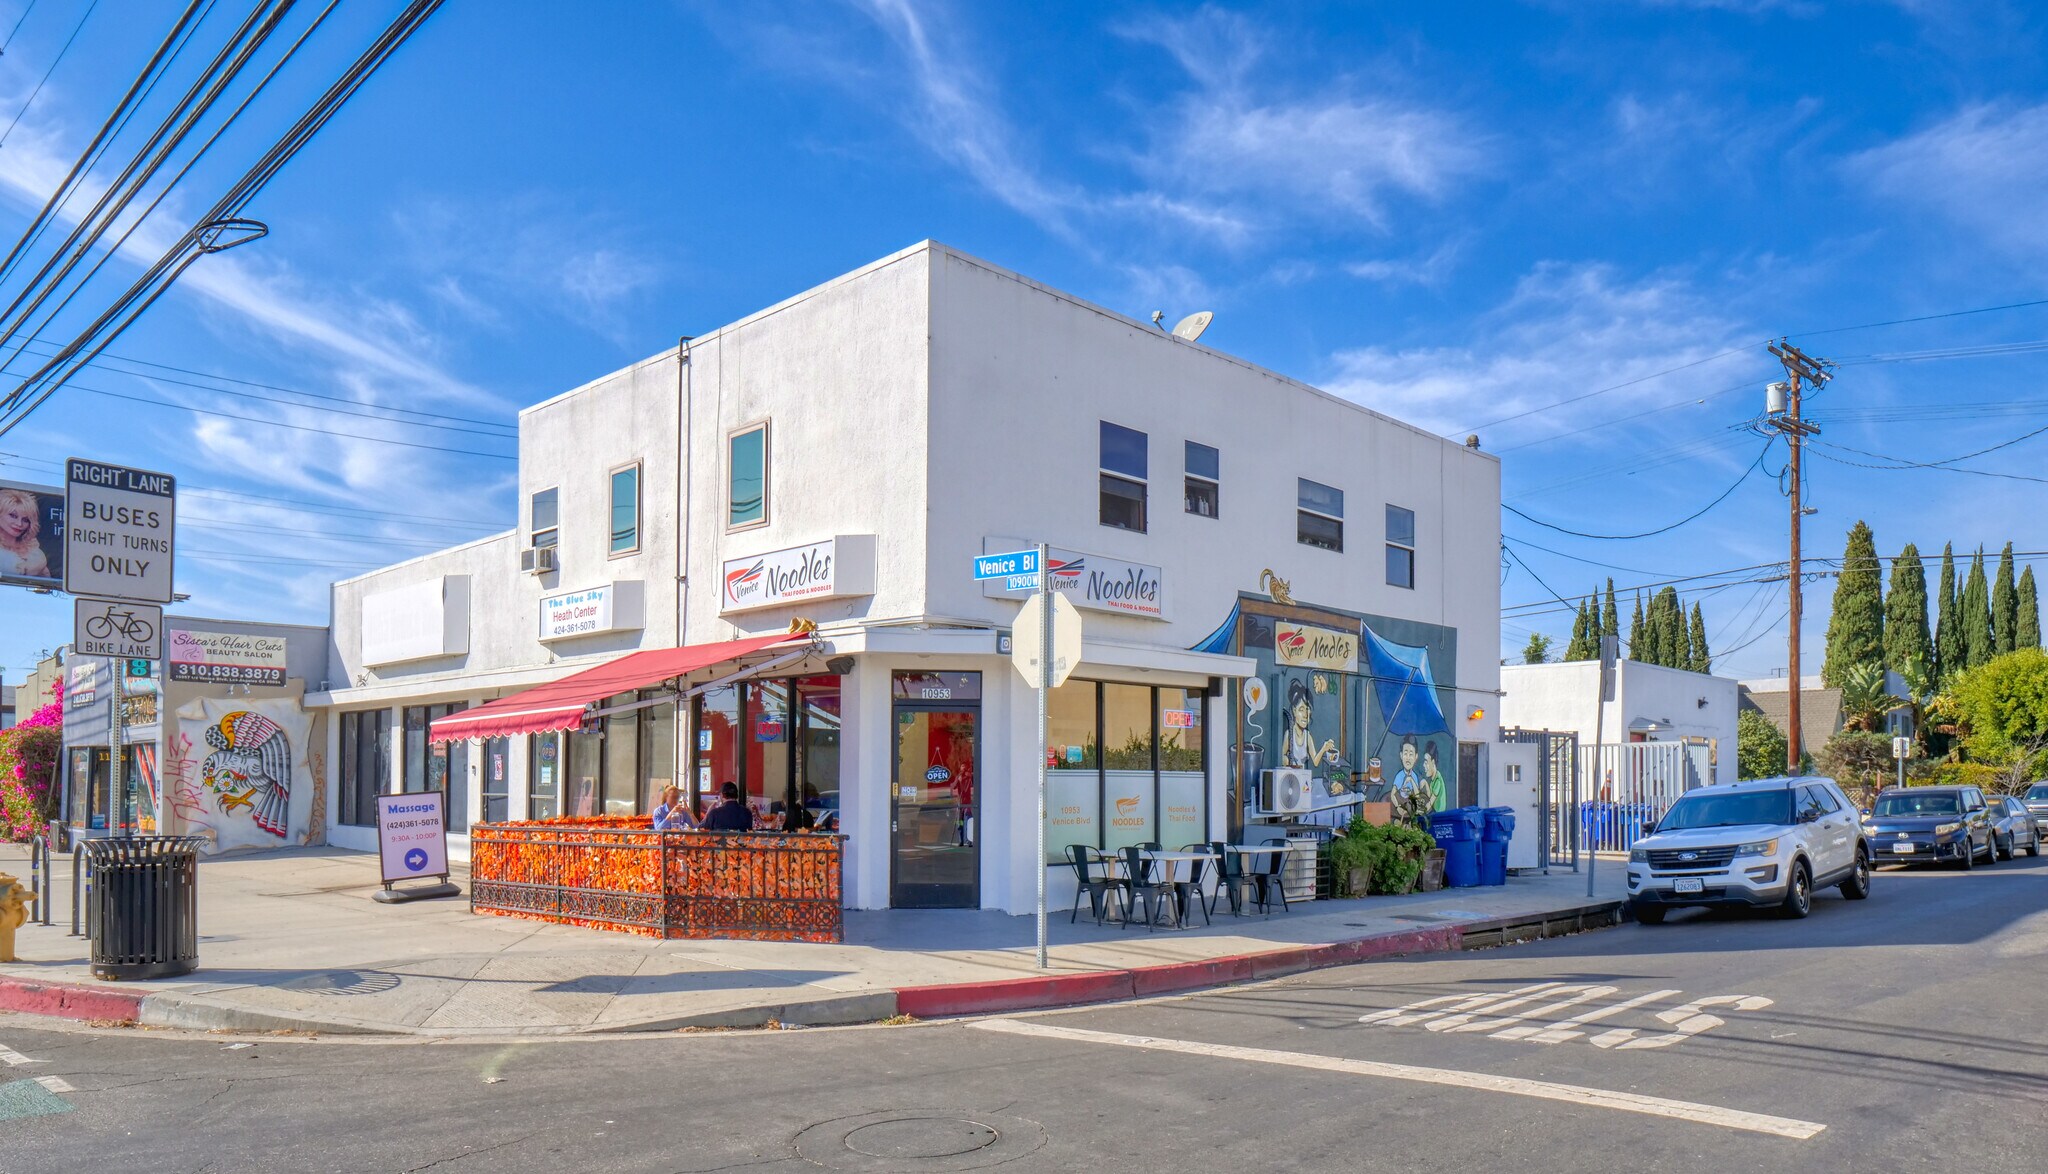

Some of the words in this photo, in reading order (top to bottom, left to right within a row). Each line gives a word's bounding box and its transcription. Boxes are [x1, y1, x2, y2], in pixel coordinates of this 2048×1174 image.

[72, 462, 122, 486] RIGHT
[128, 472, 170, 494] LANE
[82, 501, 160, 529] BUSES
[73, 528, 116, 546] RIGHT
[123, 534, 168, 554] TURNS
[91, 555, 150, 578] ONLY
[978, 558, 1016, 576] Venice
[1023, 554, 1034, 570] Bl
[736, 581, 759, 599] Venice
[765, 548, 832, 598] Noodles
[810, 584, 832, 593] NOODLES
[1050, 576, 1079, 591] Venice
[1086, 568, 1158, 602] Noodles
[548, 598, 563, 608] The
[566, 595, 584, 605] Blue
[552, 609, 573, 622] Heath
[573, 605, 598, 619] Center
[1138, 606, 1160, 614] NOODLES
[553, 620, 596, 635] 424-361-5078
[85, 641, 114, 654] BIKE
[120, 644, 151, 657] LANE
[173, 634, 218, 646] Sista's
[220, 636, 252, 650] Hair
[254, 639, 284, 652] Cuts
[1307, 635, 1352, 660] Noodles
[206, 648, 241, 657] BEAUTY
[244, 651, 273, 659] SALON
[178, 663, 280, 680] 310.838.3879
[922, 688, 951, 699] 10953
[1165, 711, 1192, 726] OPEN
[927, 772, 948, 780] OPEN
[388, 803, 435, 814] Massage
[386, 818, 439, 830] (424)361-5078
[1112, 817, 1145, 827] NOODLES
[416, 832, 437, 841] 10:00P
